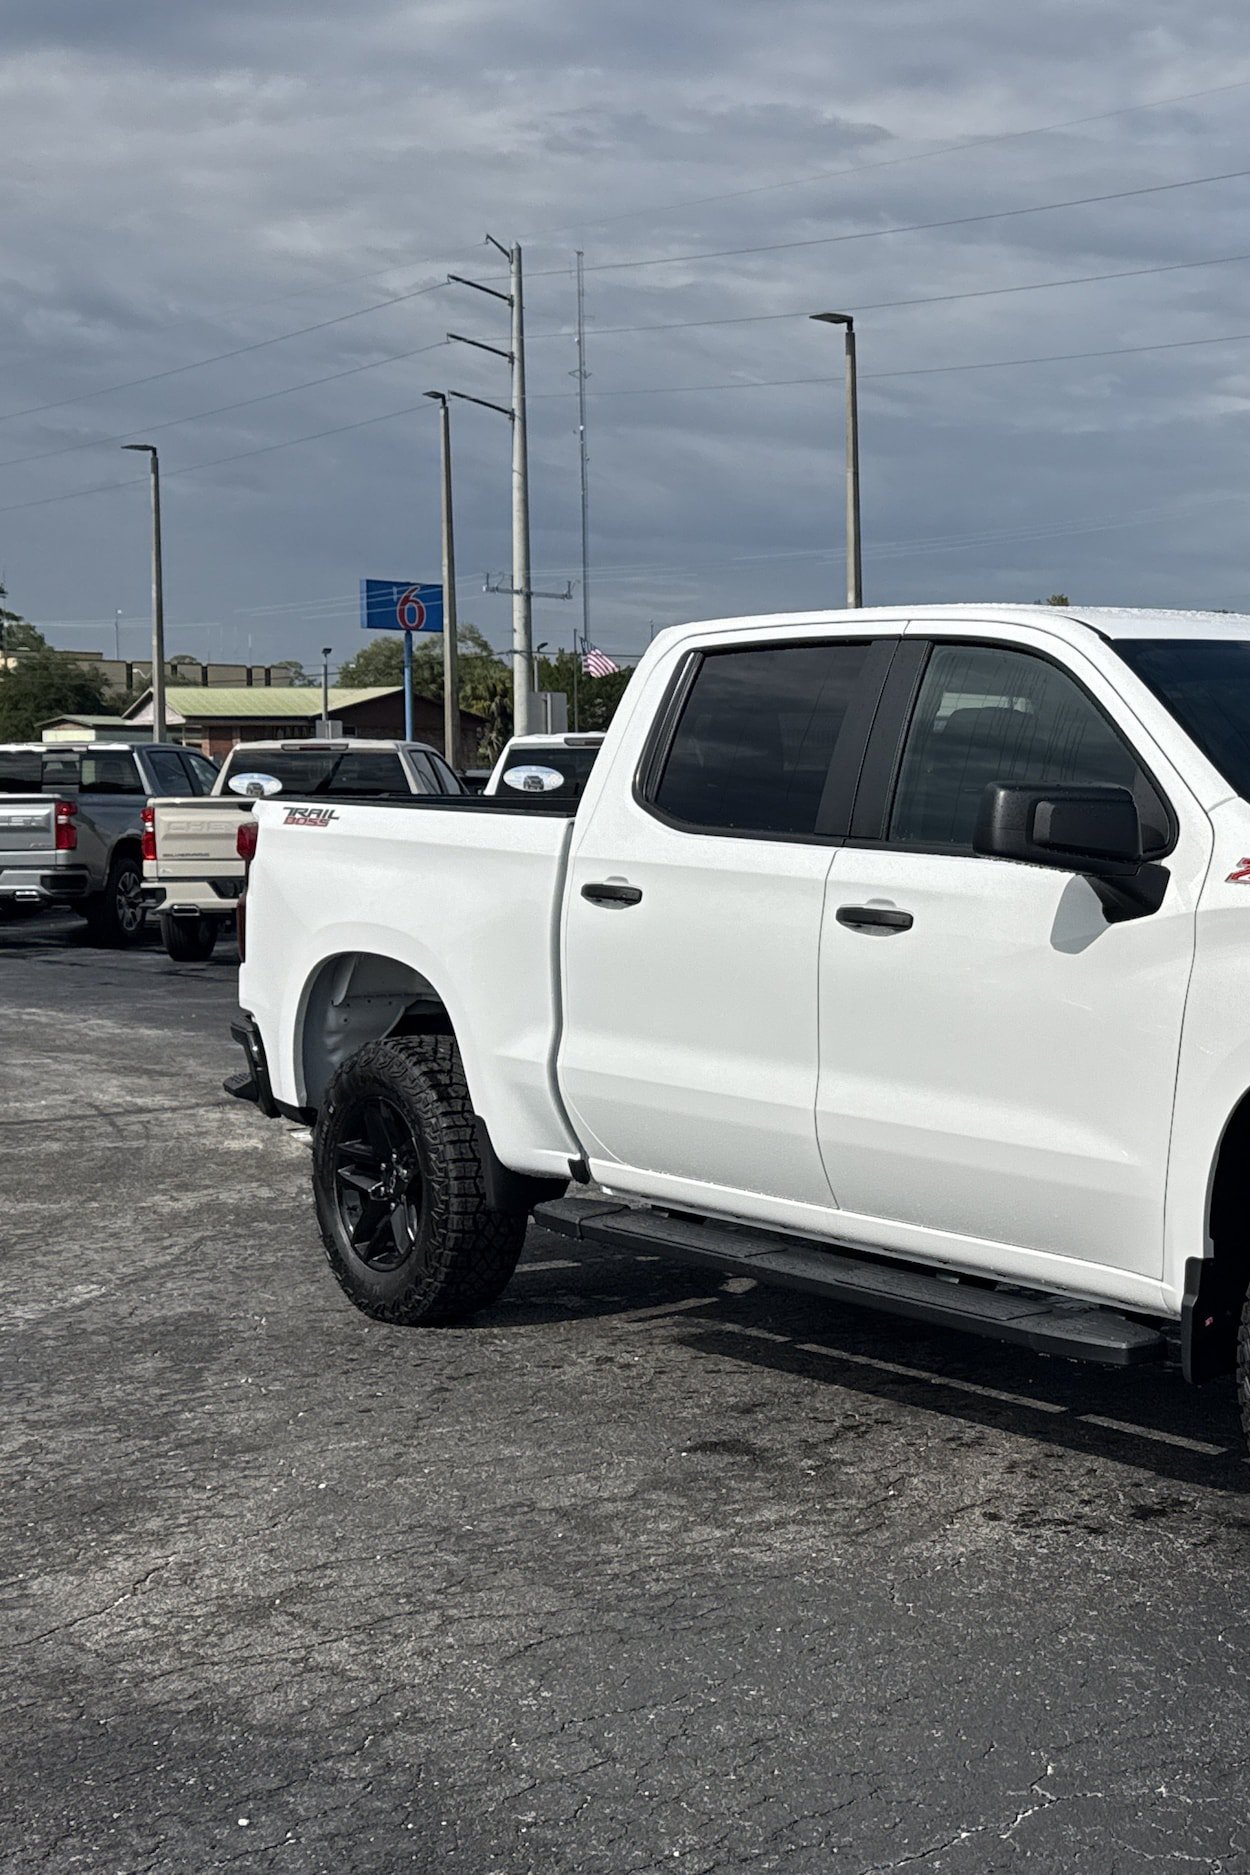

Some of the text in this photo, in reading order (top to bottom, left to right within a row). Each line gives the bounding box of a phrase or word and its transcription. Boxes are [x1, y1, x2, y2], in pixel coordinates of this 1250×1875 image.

[396, 584, 426, 630] 6
[283, 806, 340, 820] TRAIL
[283, 816, 330, 827] BOSS
